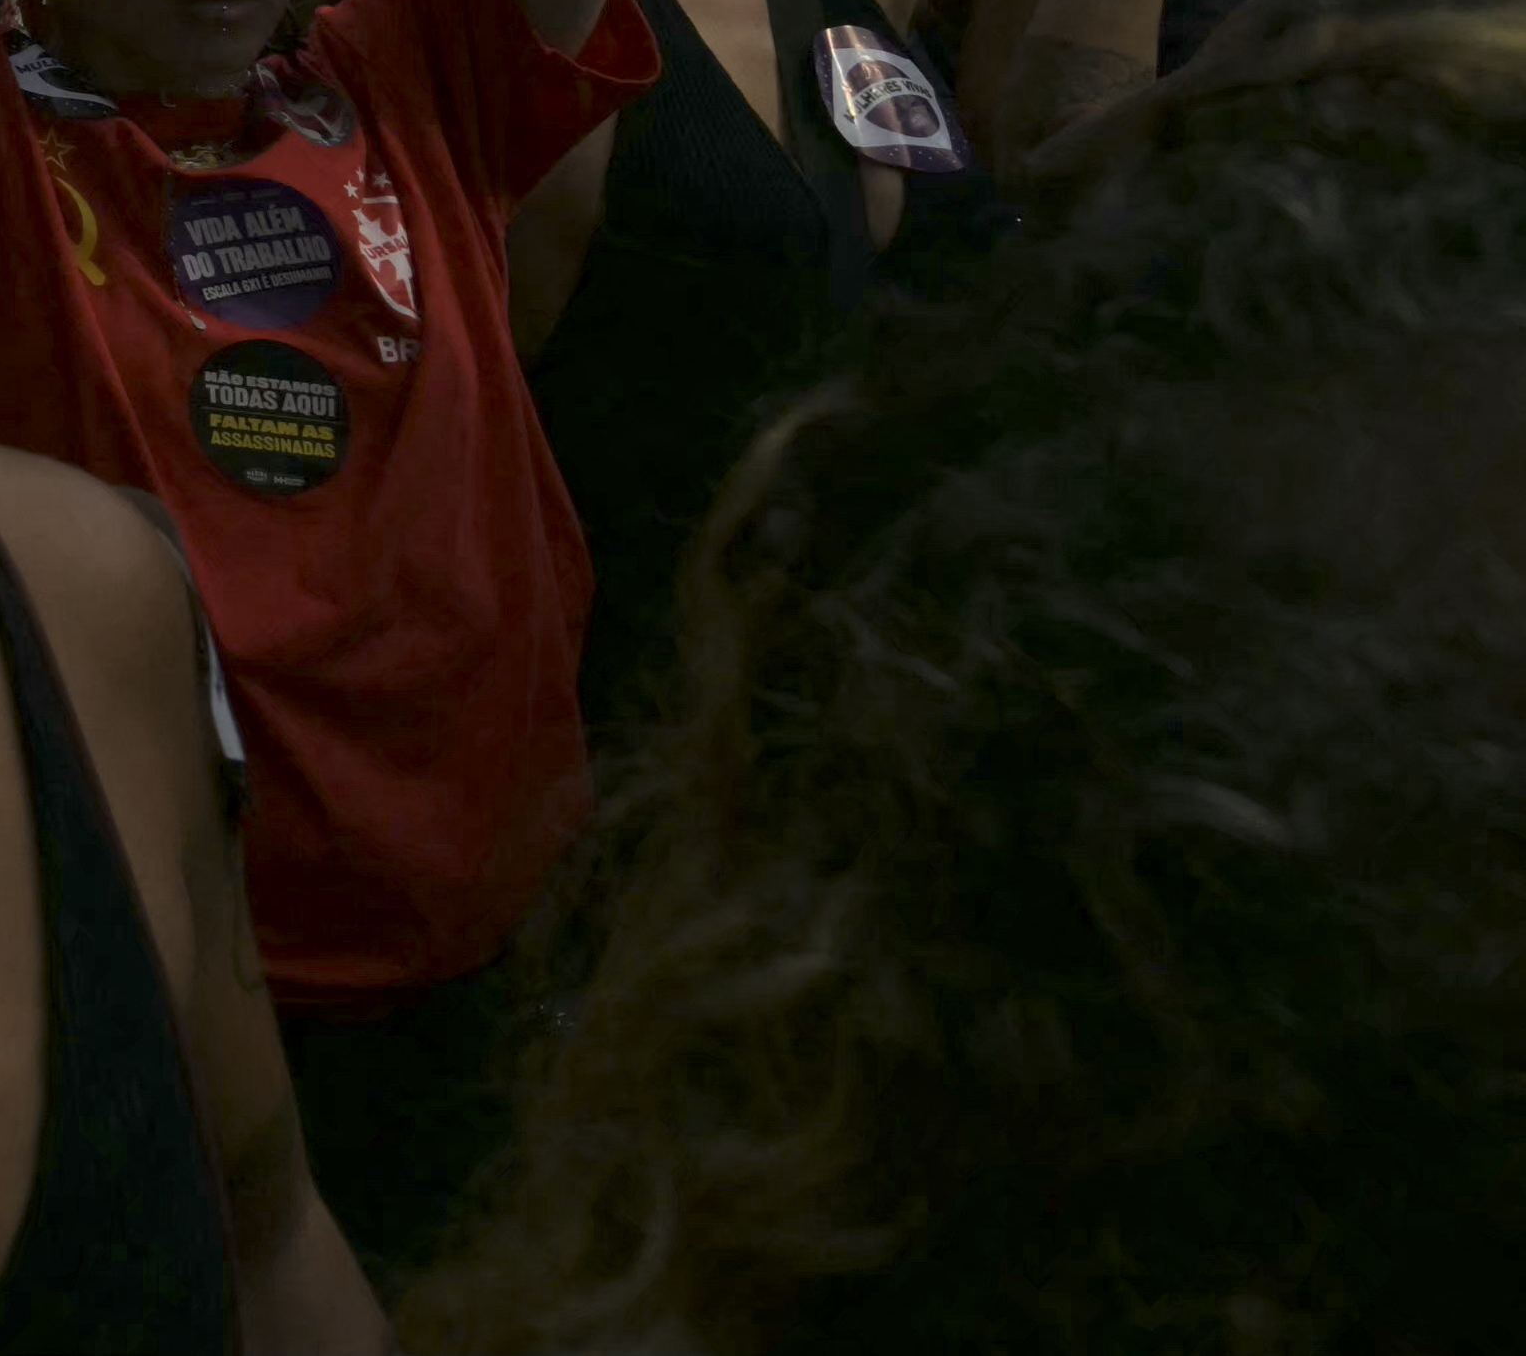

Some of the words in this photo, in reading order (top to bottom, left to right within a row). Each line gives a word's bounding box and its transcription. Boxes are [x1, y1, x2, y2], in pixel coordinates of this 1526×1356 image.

[183, 214, 243, 247] VIDA
[243, 202, 306, 239] ALÉM
[182, 252, 216, 282] DO
[215, 235, 332, 275] TRABALHO
[201, 280, 243, 301] ESCALA
[203, 369, 244, 386] NÃO
[246, 375, 337, 397] ESTAMOS
[205, 383, 279, 410] TODAS
[281, 393, 336, 417] AQUI
[208, 413, 299, 437] FALTAM
[302, 424, 335, 441] AS
[210, 429, 336, 459] ASSASSINADAS
